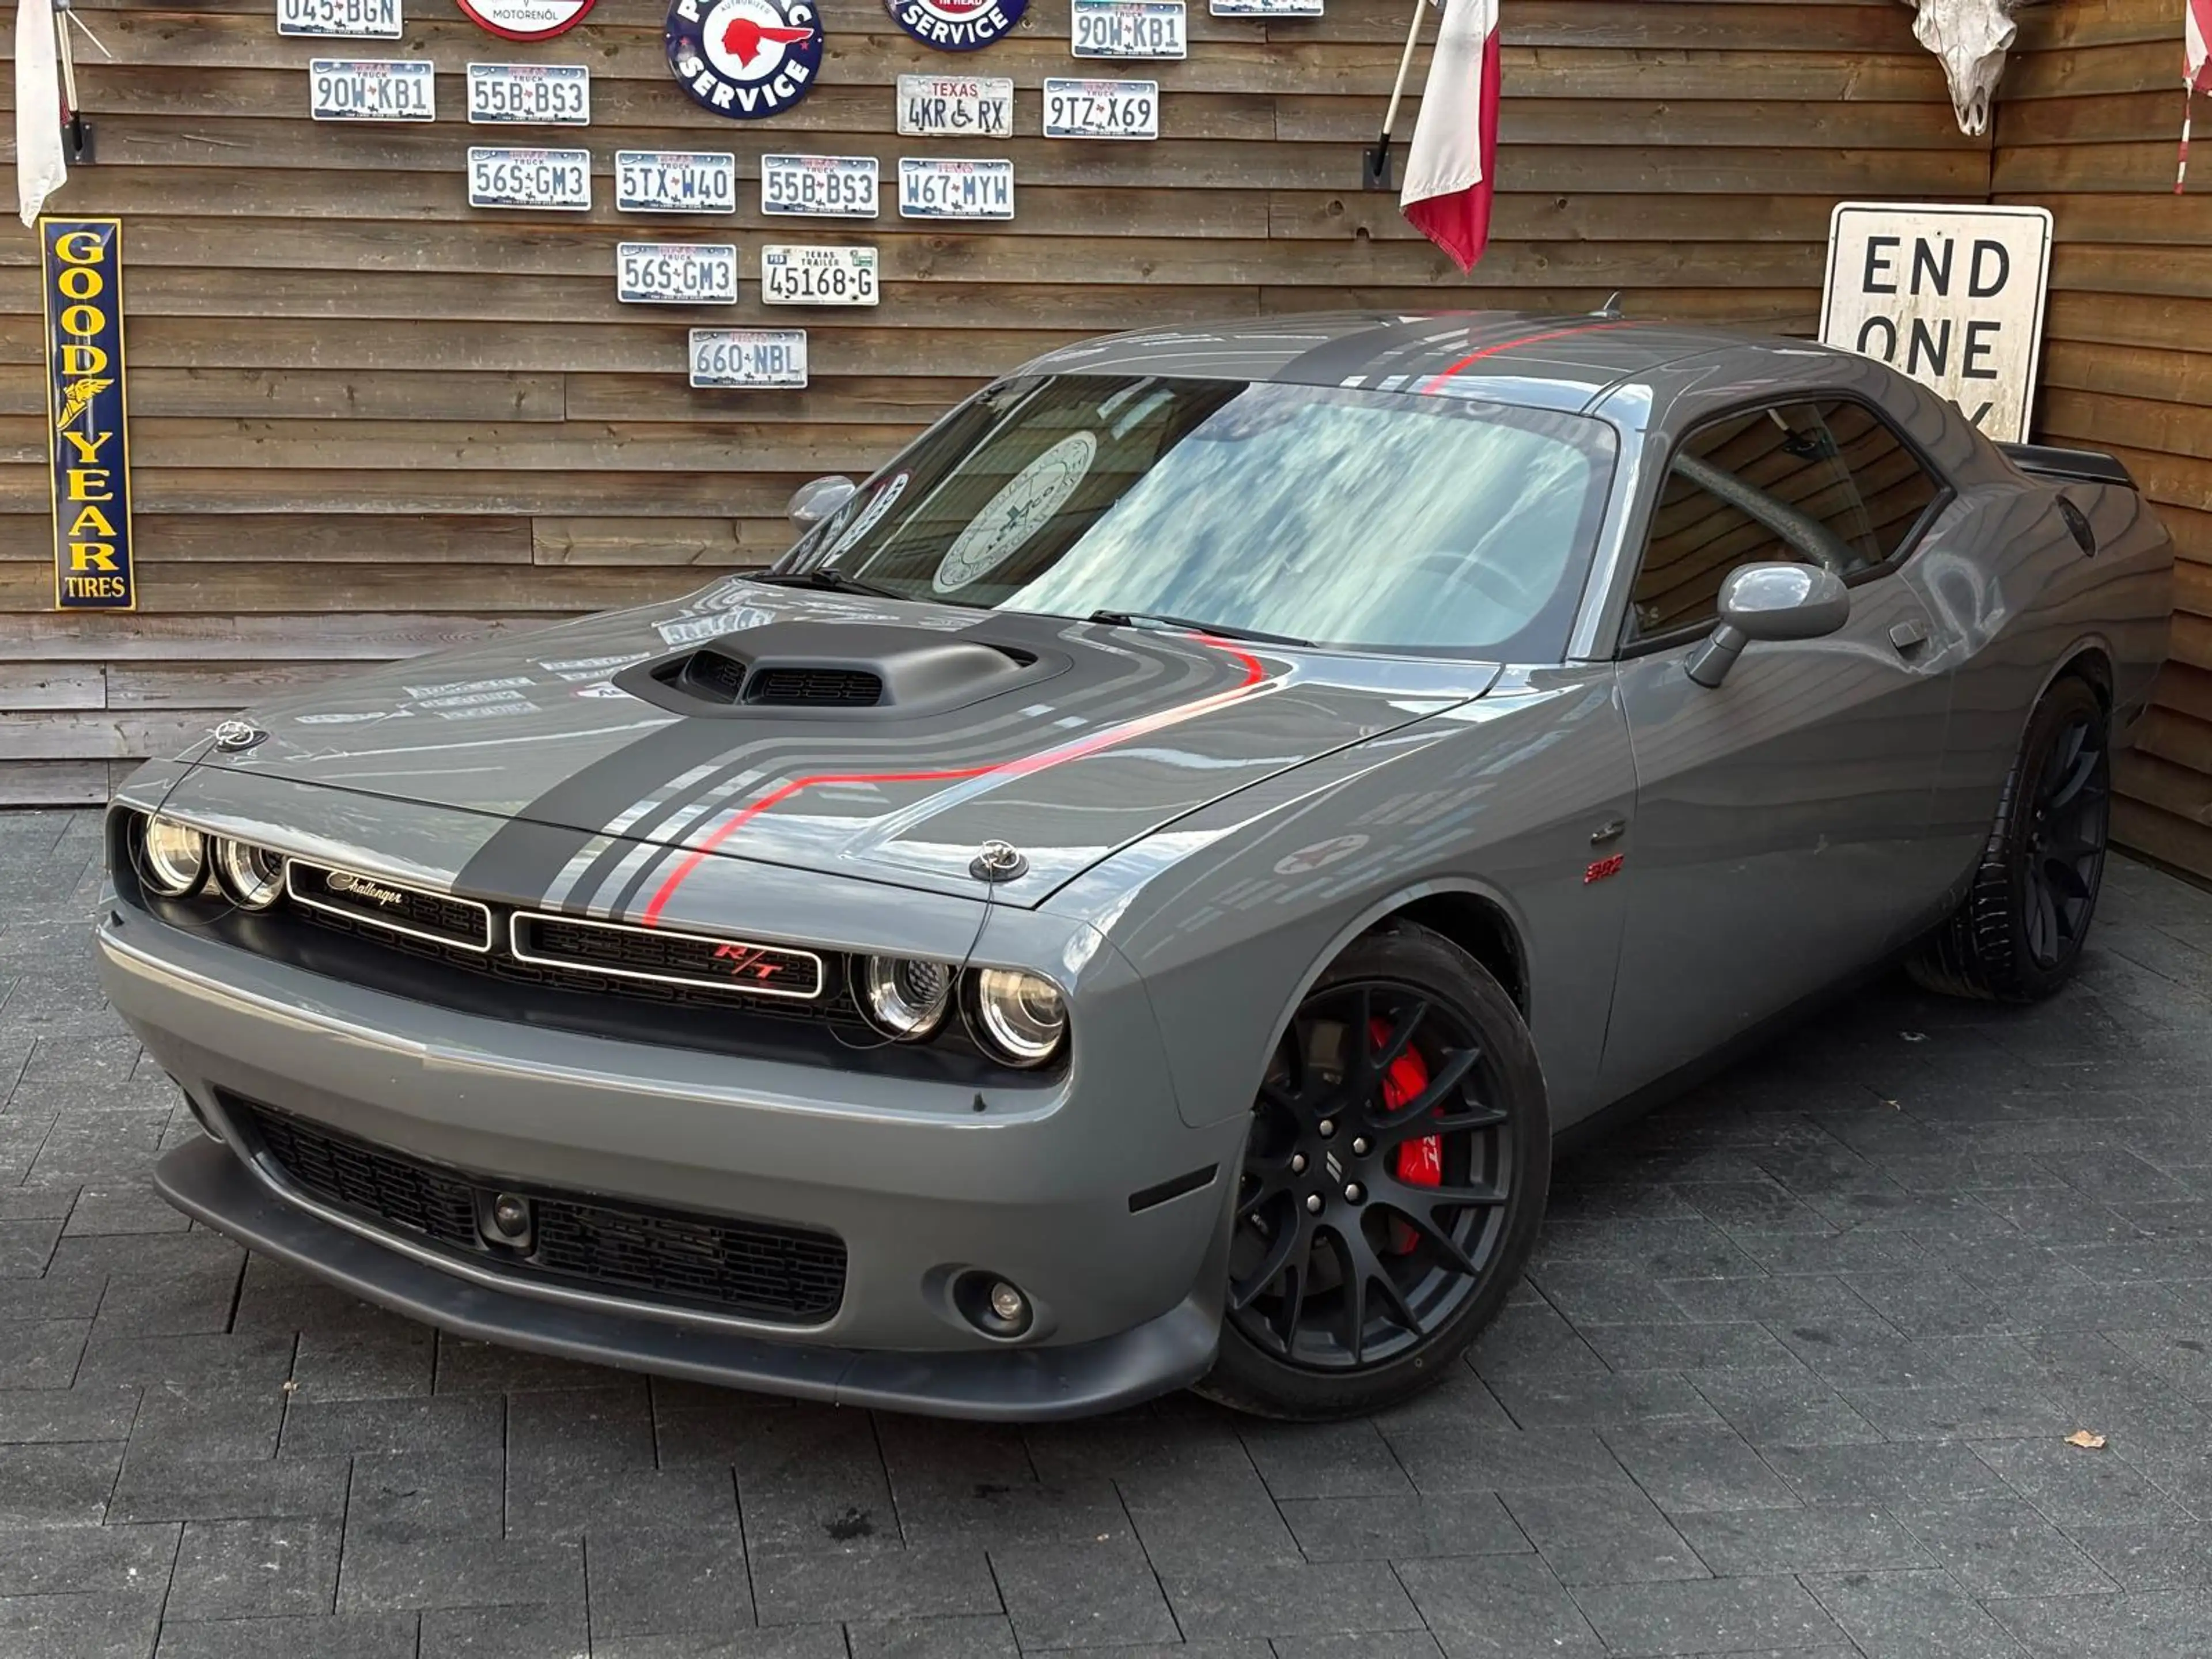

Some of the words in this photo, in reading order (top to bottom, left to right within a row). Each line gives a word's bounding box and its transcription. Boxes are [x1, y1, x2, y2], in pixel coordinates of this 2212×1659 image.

[493, 9, 559, 20] MOTORENÖL
[902, 5, 1009, 44] SERVICE
[679, 56, 810, 112] SERVICE
[932, 82, 978, 97] TEXAS
[909, 97, 946, 128] 4KR
[979, 100, 1004, 130] RX
[1862, 236, 2010, 298] END
[1856, 315, 2001, 380] ONE
[65, 576, 126, 598] TIRES
[326, 872, 403, 906] Challenger
[714, 944, 784, 979] R/T
